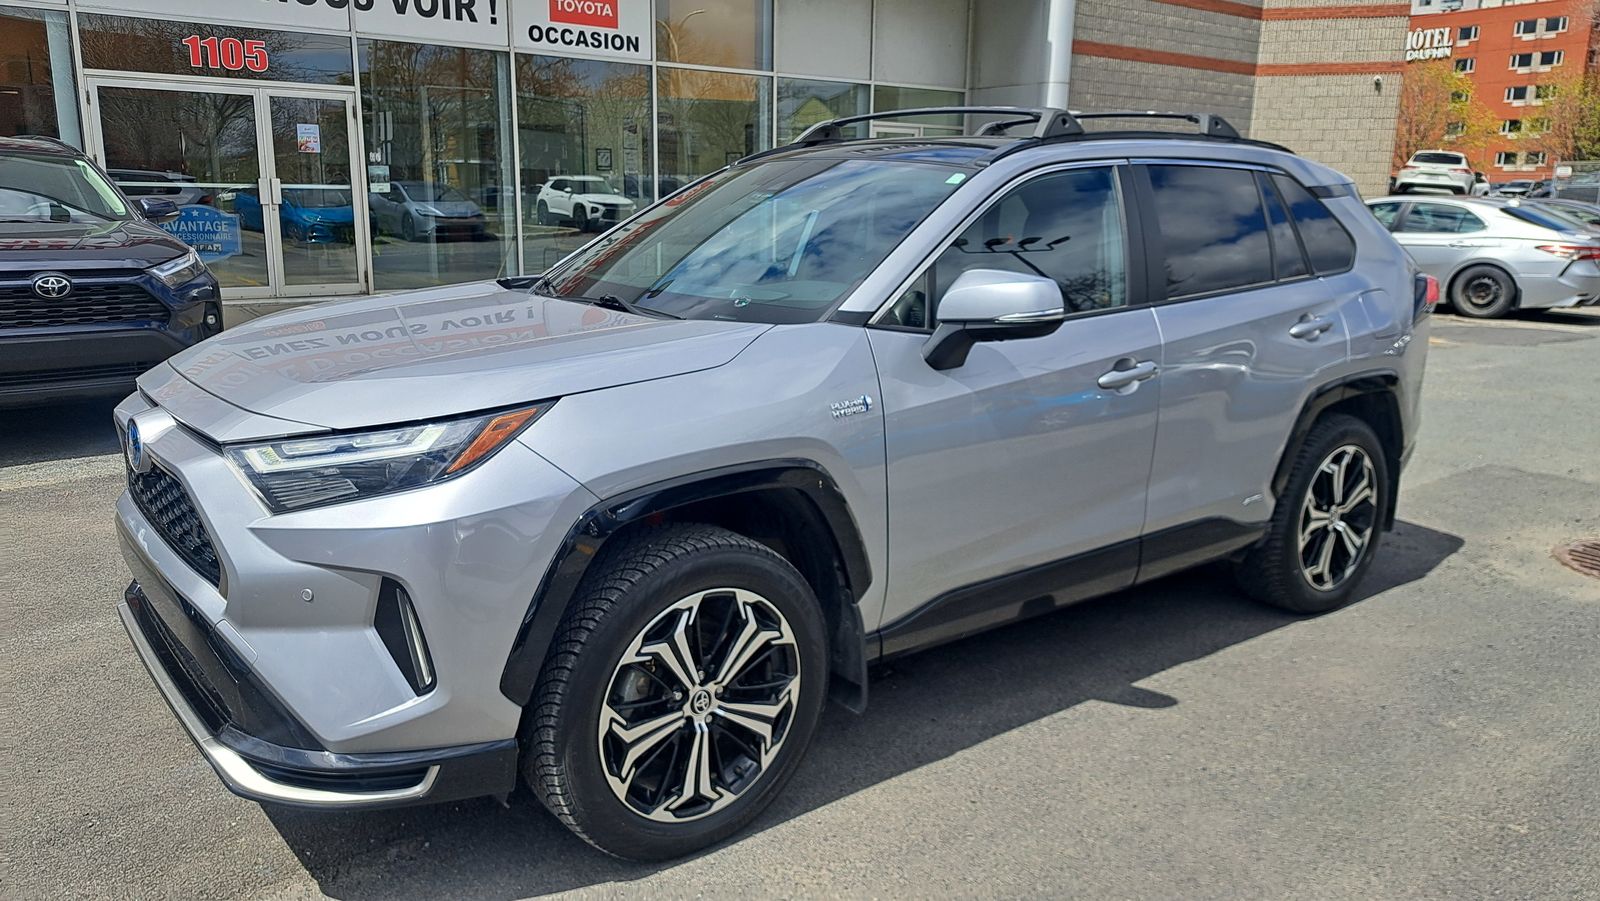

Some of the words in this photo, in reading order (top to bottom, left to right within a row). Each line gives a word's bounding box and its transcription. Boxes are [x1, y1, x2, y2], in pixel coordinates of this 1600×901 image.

[556, 0, 613, 17] TOYOTA
[528, 25, 640, 53] OCCASION
[182, 35, 269, 72] 1105
[1405, 47, 1452, 61] DAUPHIN
[163, 220, 229, 232] AVANTAGE
[831, 405, 865, 417] HYBRID
